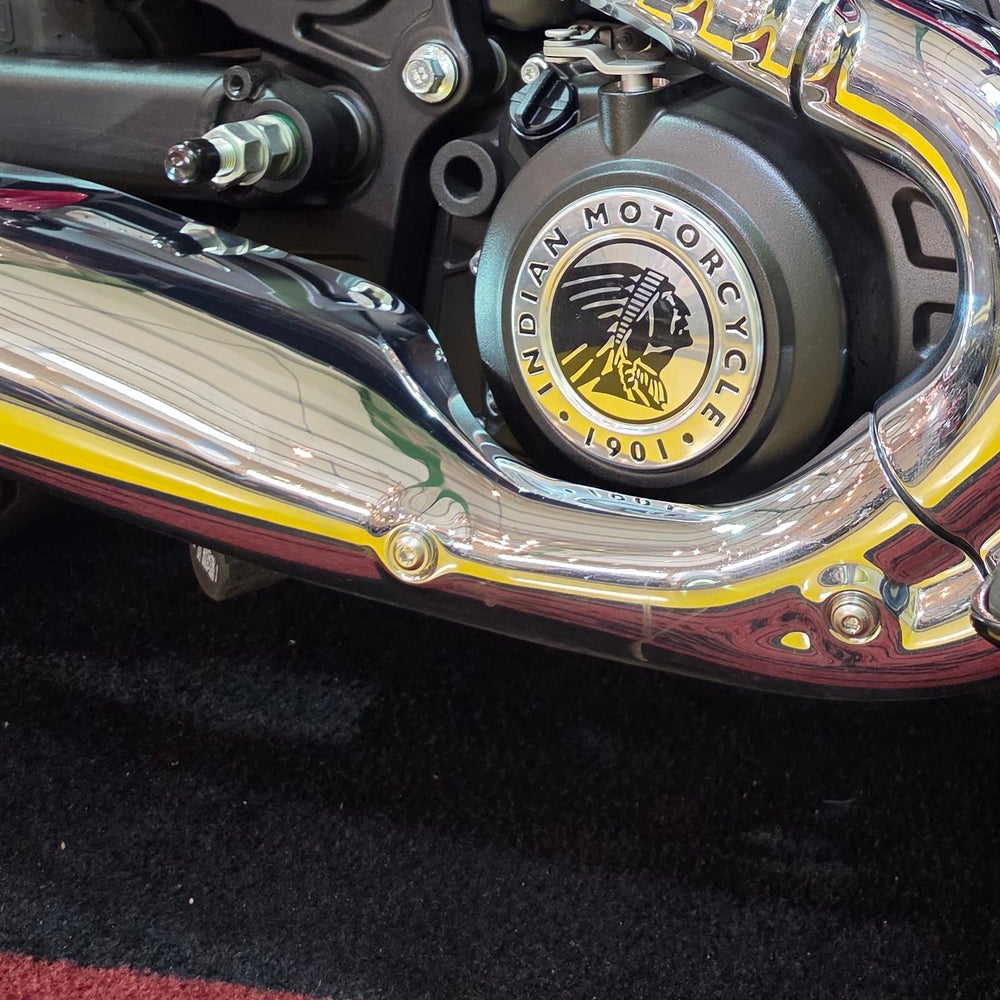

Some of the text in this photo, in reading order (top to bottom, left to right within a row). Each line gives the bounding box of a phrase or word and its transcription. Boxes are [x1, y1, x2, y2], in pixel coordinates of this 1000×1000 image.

[519, 201, 748, 427] INDIAN MOTORCYCLE
[585, 428, 669, 462] 1901
